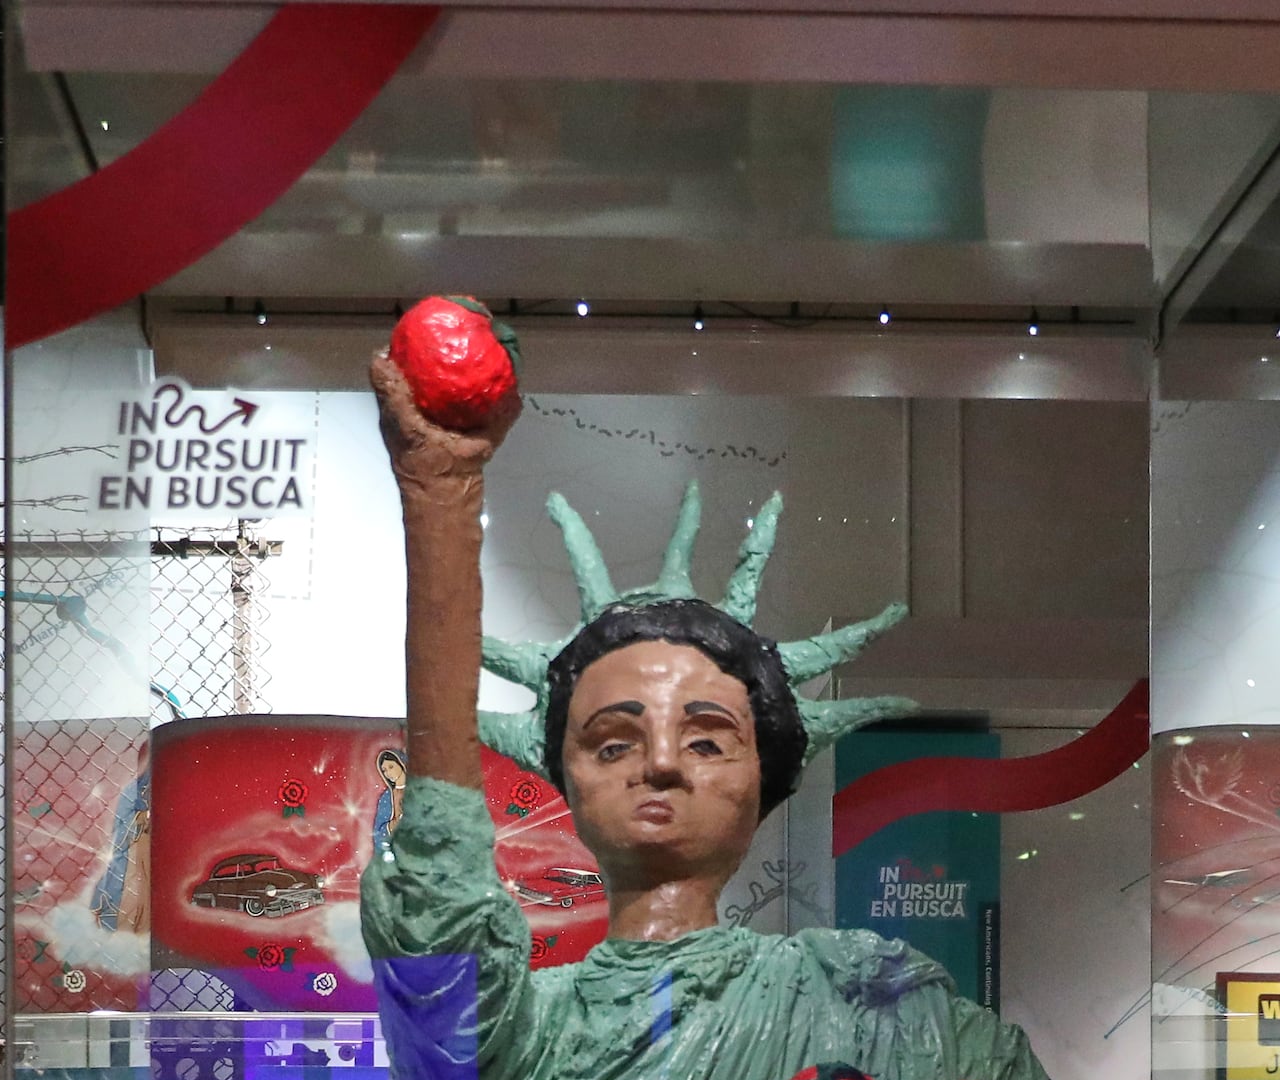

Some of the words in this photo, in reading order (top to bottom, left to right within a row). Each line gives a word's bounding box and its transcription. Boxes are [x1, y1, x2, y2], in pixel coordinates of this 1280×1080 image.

[118, 401, 158, 435] IN
[127, 438, 307, 472] PURSUIT
[98, 476, 153, 510] EN
[167, 476, 304, 510] BUSCA
[880, 866, 900, 883] IN
[884, 883, 967, 900] PURSUIT
[870, 900, 896, 917] EN
[901, 900, 965, 917] BUSCA
